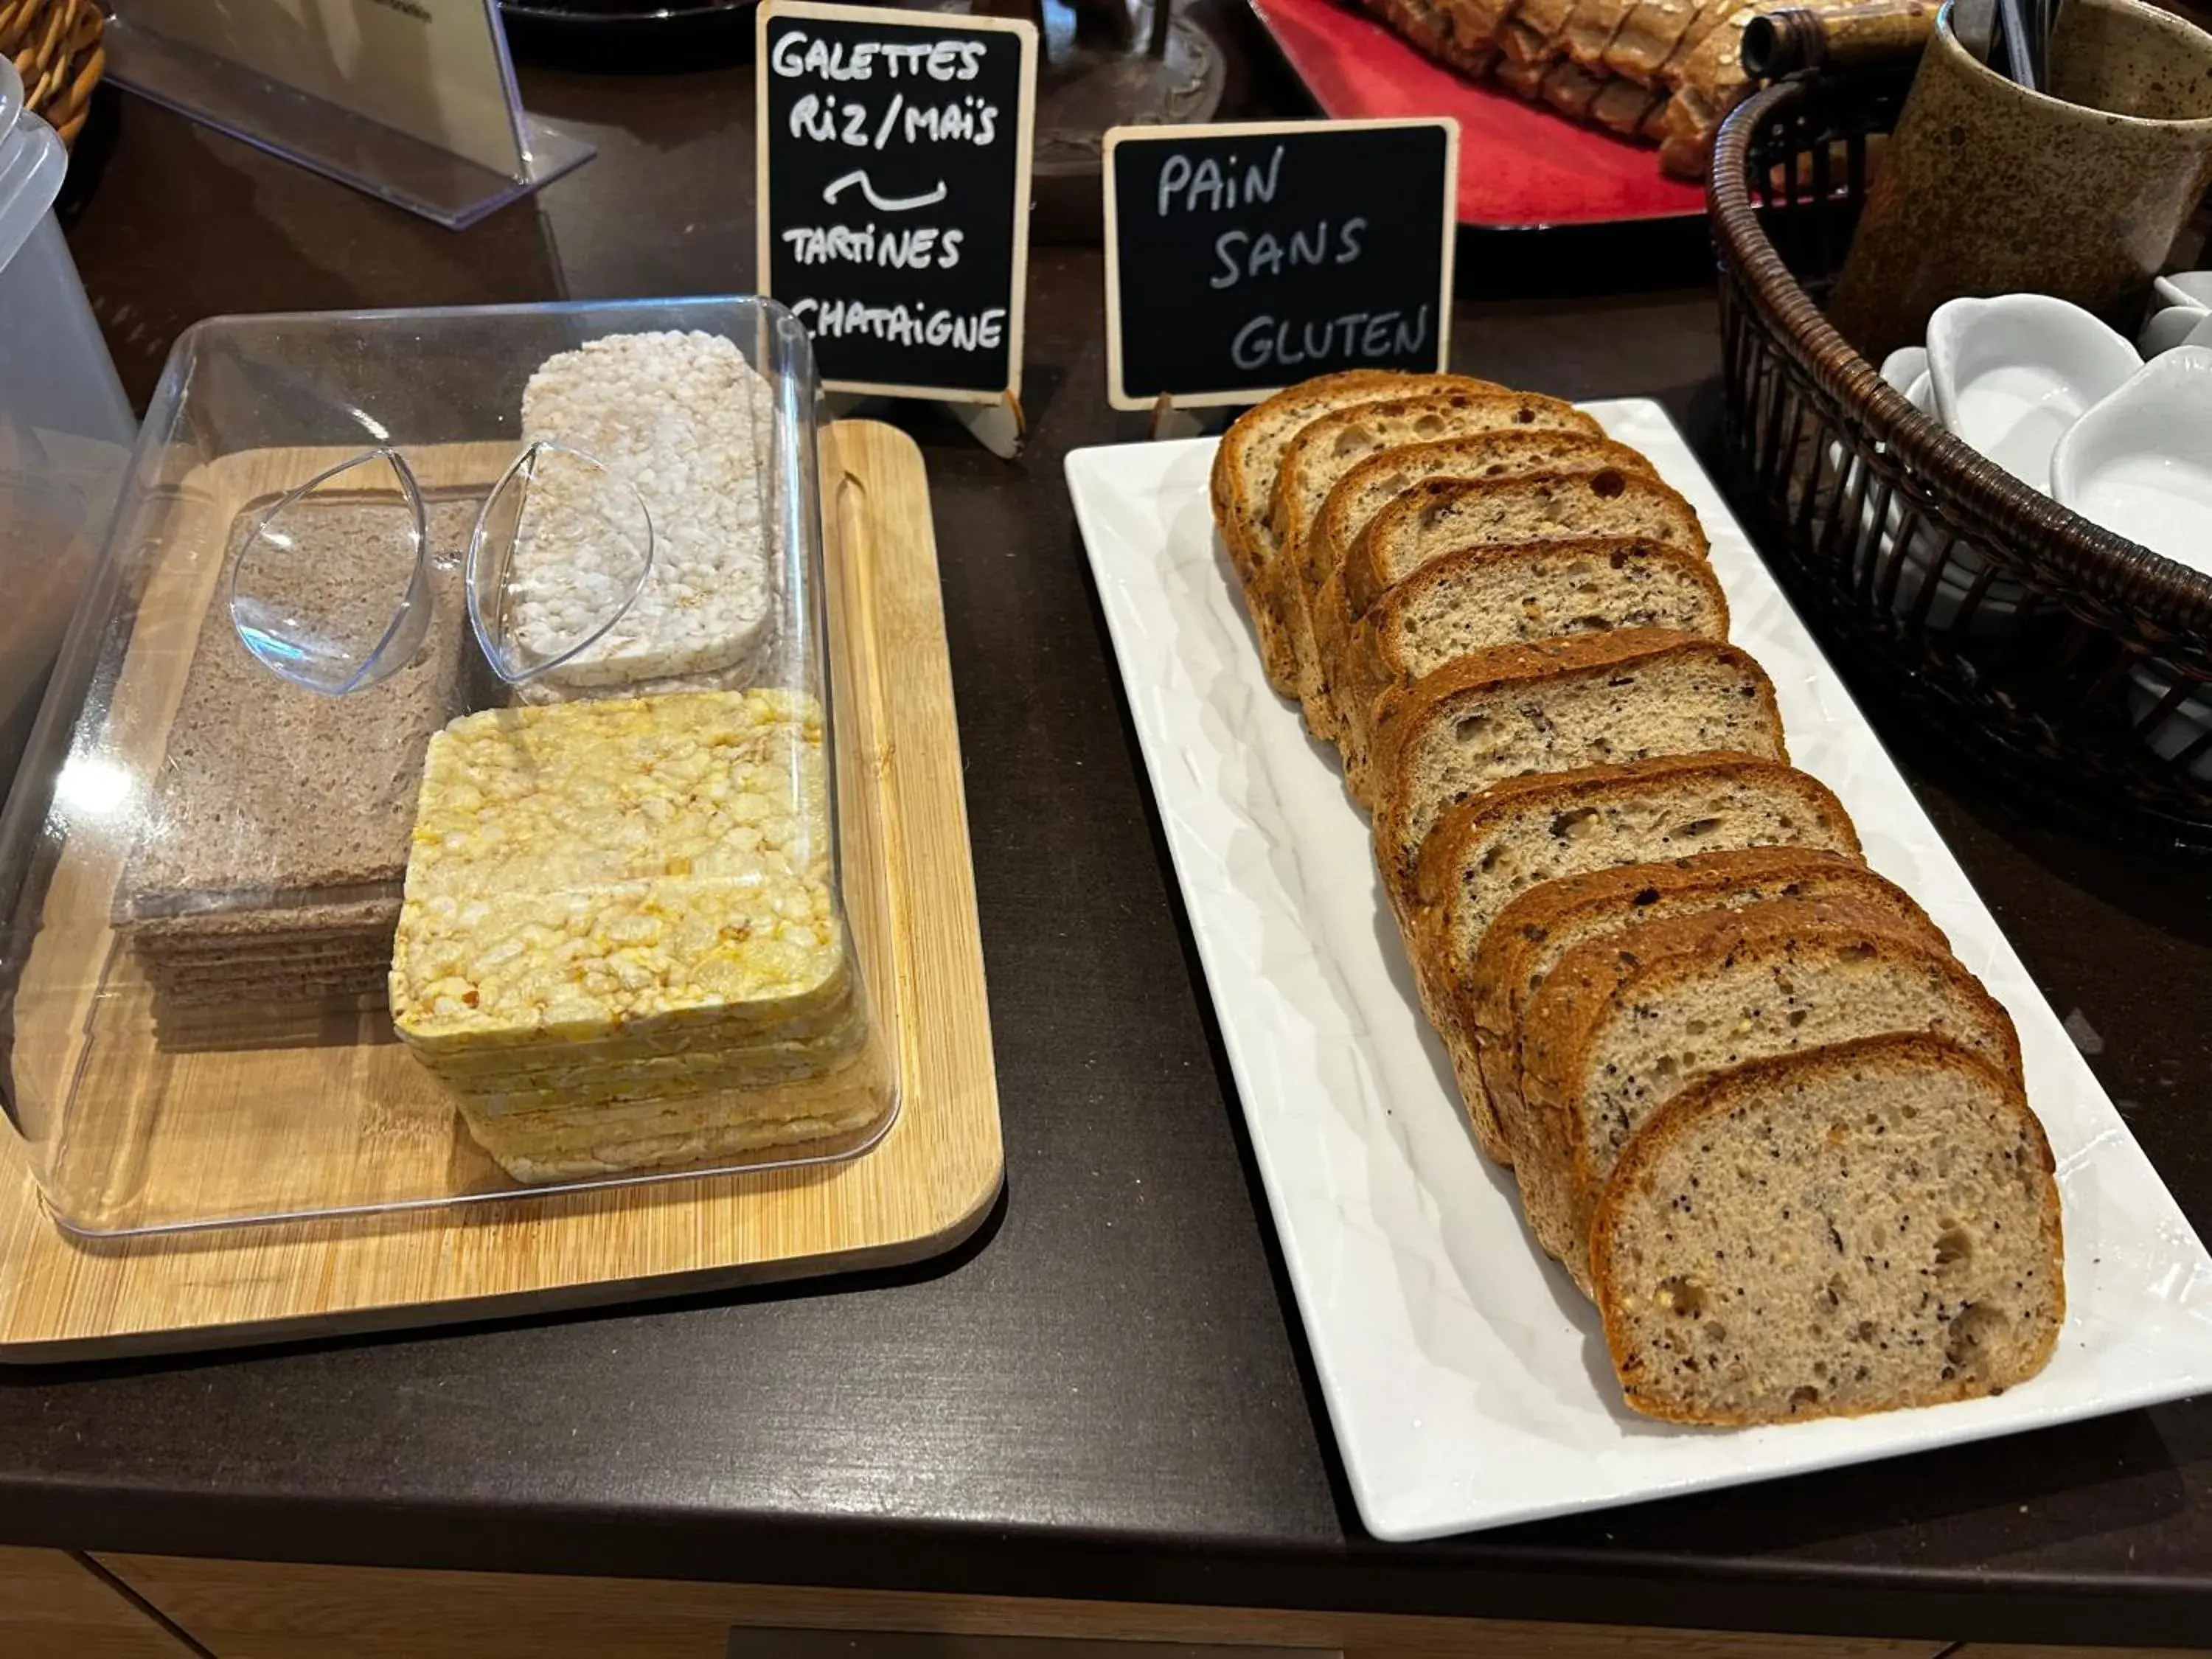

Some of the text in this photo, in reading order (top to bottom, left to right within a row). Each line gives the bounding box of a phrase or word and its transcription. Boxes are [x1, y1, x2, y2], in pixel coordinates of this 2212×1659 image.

[772, 31, 987, 80] GALETTES
[1210, 218, 1367, 289] SANS
[1231, 304, 1429, 369] GLUTEN
